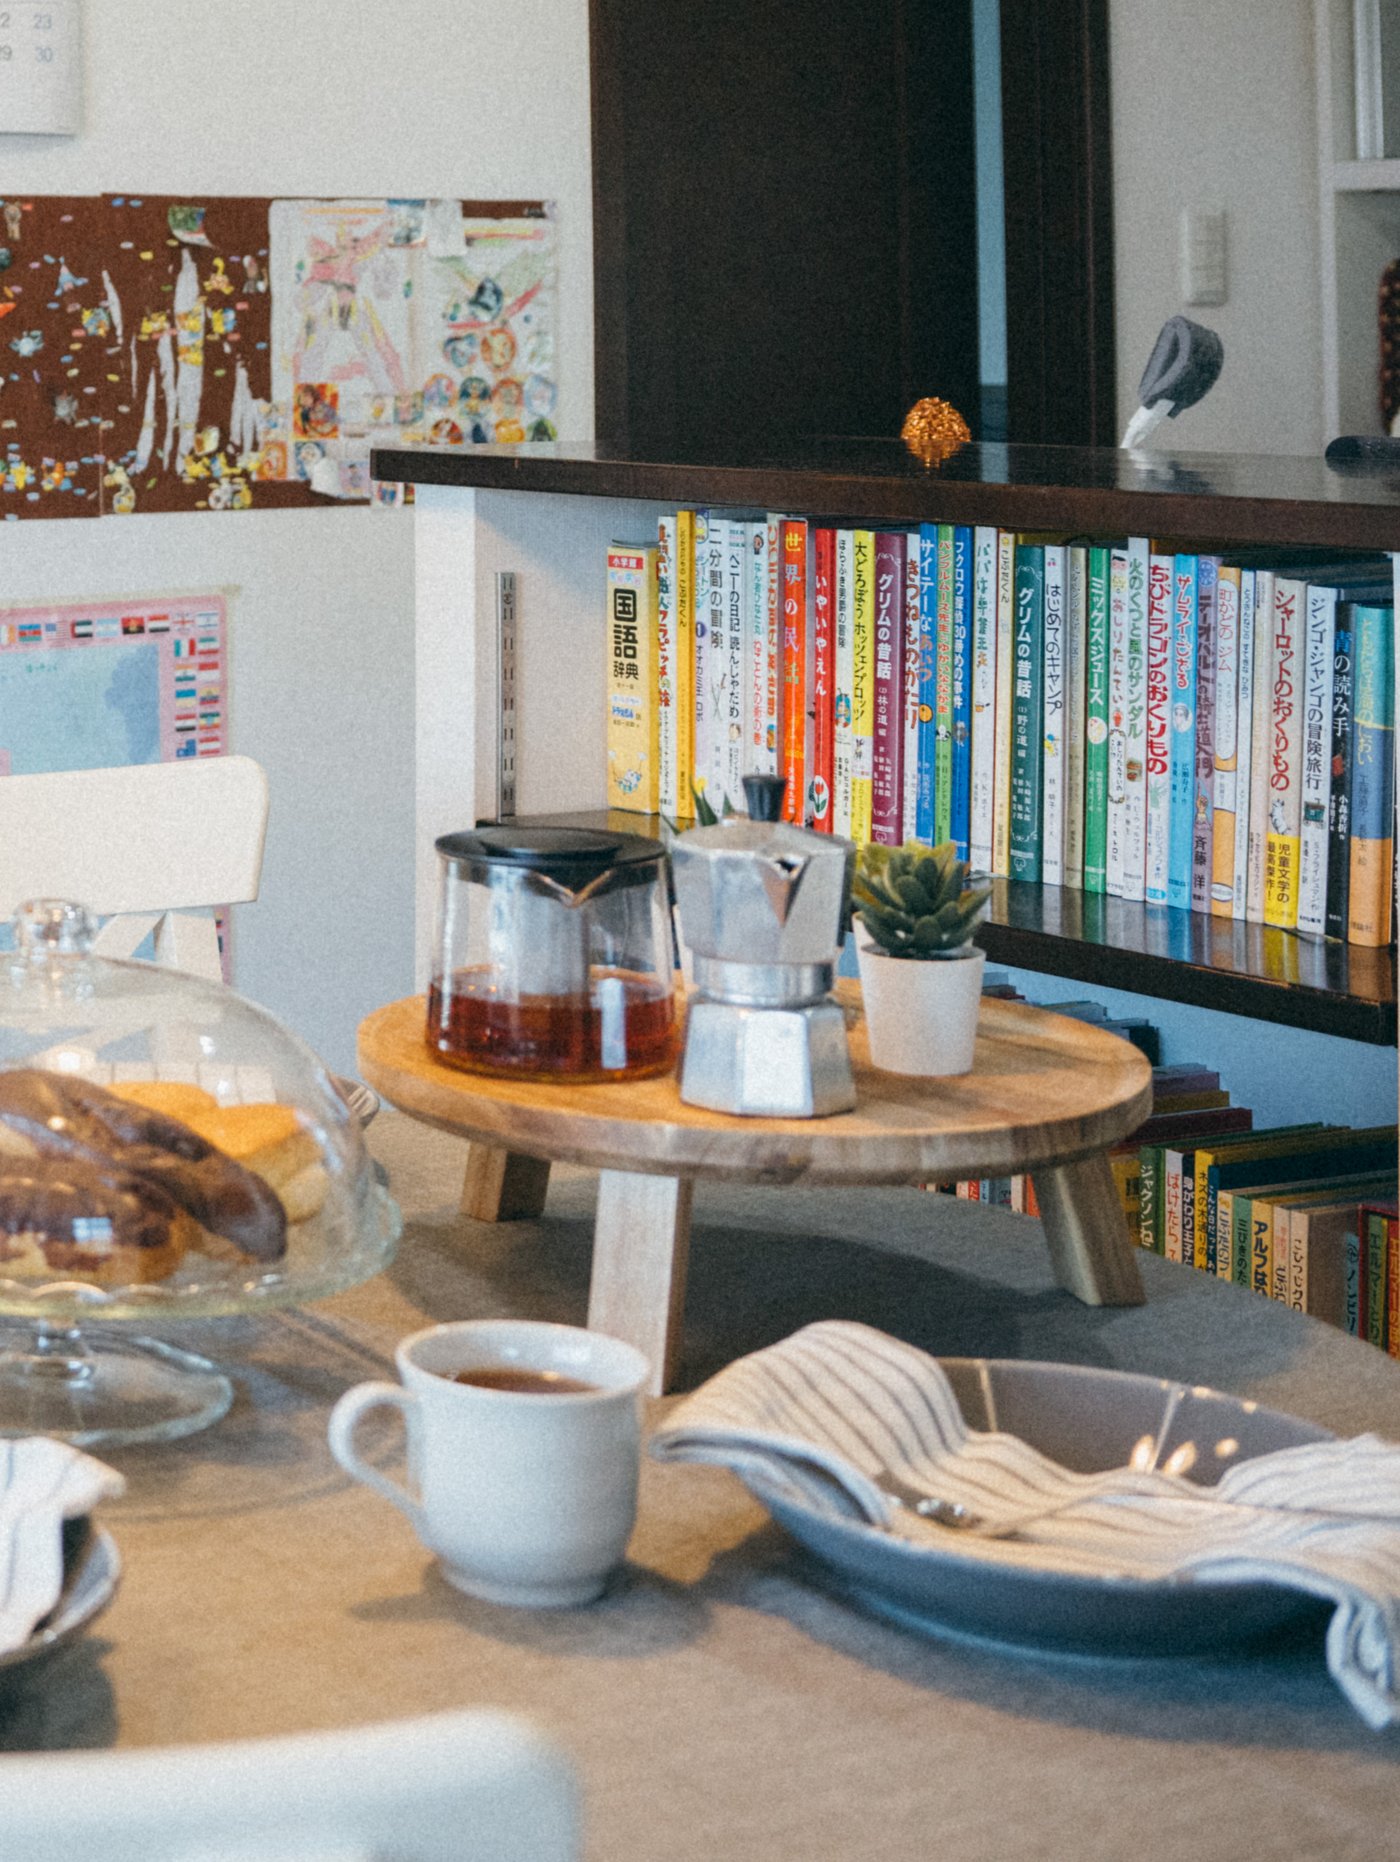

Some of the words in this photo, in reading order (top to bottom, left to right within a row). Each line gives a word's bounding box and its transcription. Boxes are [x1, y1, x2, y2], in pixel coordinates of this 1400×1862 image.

[709, 528, 724, 649] 二分間の冒険
[784, 531, 803, 685] 世界の民話
[815, 575, 827, 696] いやいやえん
[853, 541, 870, 721] 大どろぼうホッツェンプロッツ
[875, 573, 894, 680] グリムの昔話
[919, 539, 935, 682] サイテーなあいつ
[1016, 587, 1035, 698] グリムの昔話
[1046, 583, 1063, 715] はじめてのキャンプ
[1089, 576, 1105, 705] ミックスジュース
[1112, 598, 1125, 703] おしりたんてい
[1127, 557, 1144, 739] 火のくつと風のサンダル
[1217, 588, 1234, 672] 町かどのジム
[729, 635, 740, 718] 読んじゃだめ
[1147, 564, 1171, 775] ちびドラゴンのおくりもの
[1271, 590, 1296, 791] シャーロットのおくりもの
[1306, 597, 1327, 790] ジンゴ・ジャンゴの冒険旅行
[1332, 630, 1352, 737] 青の読み手
[1276, 844, 1291, 904] 児童文学の
